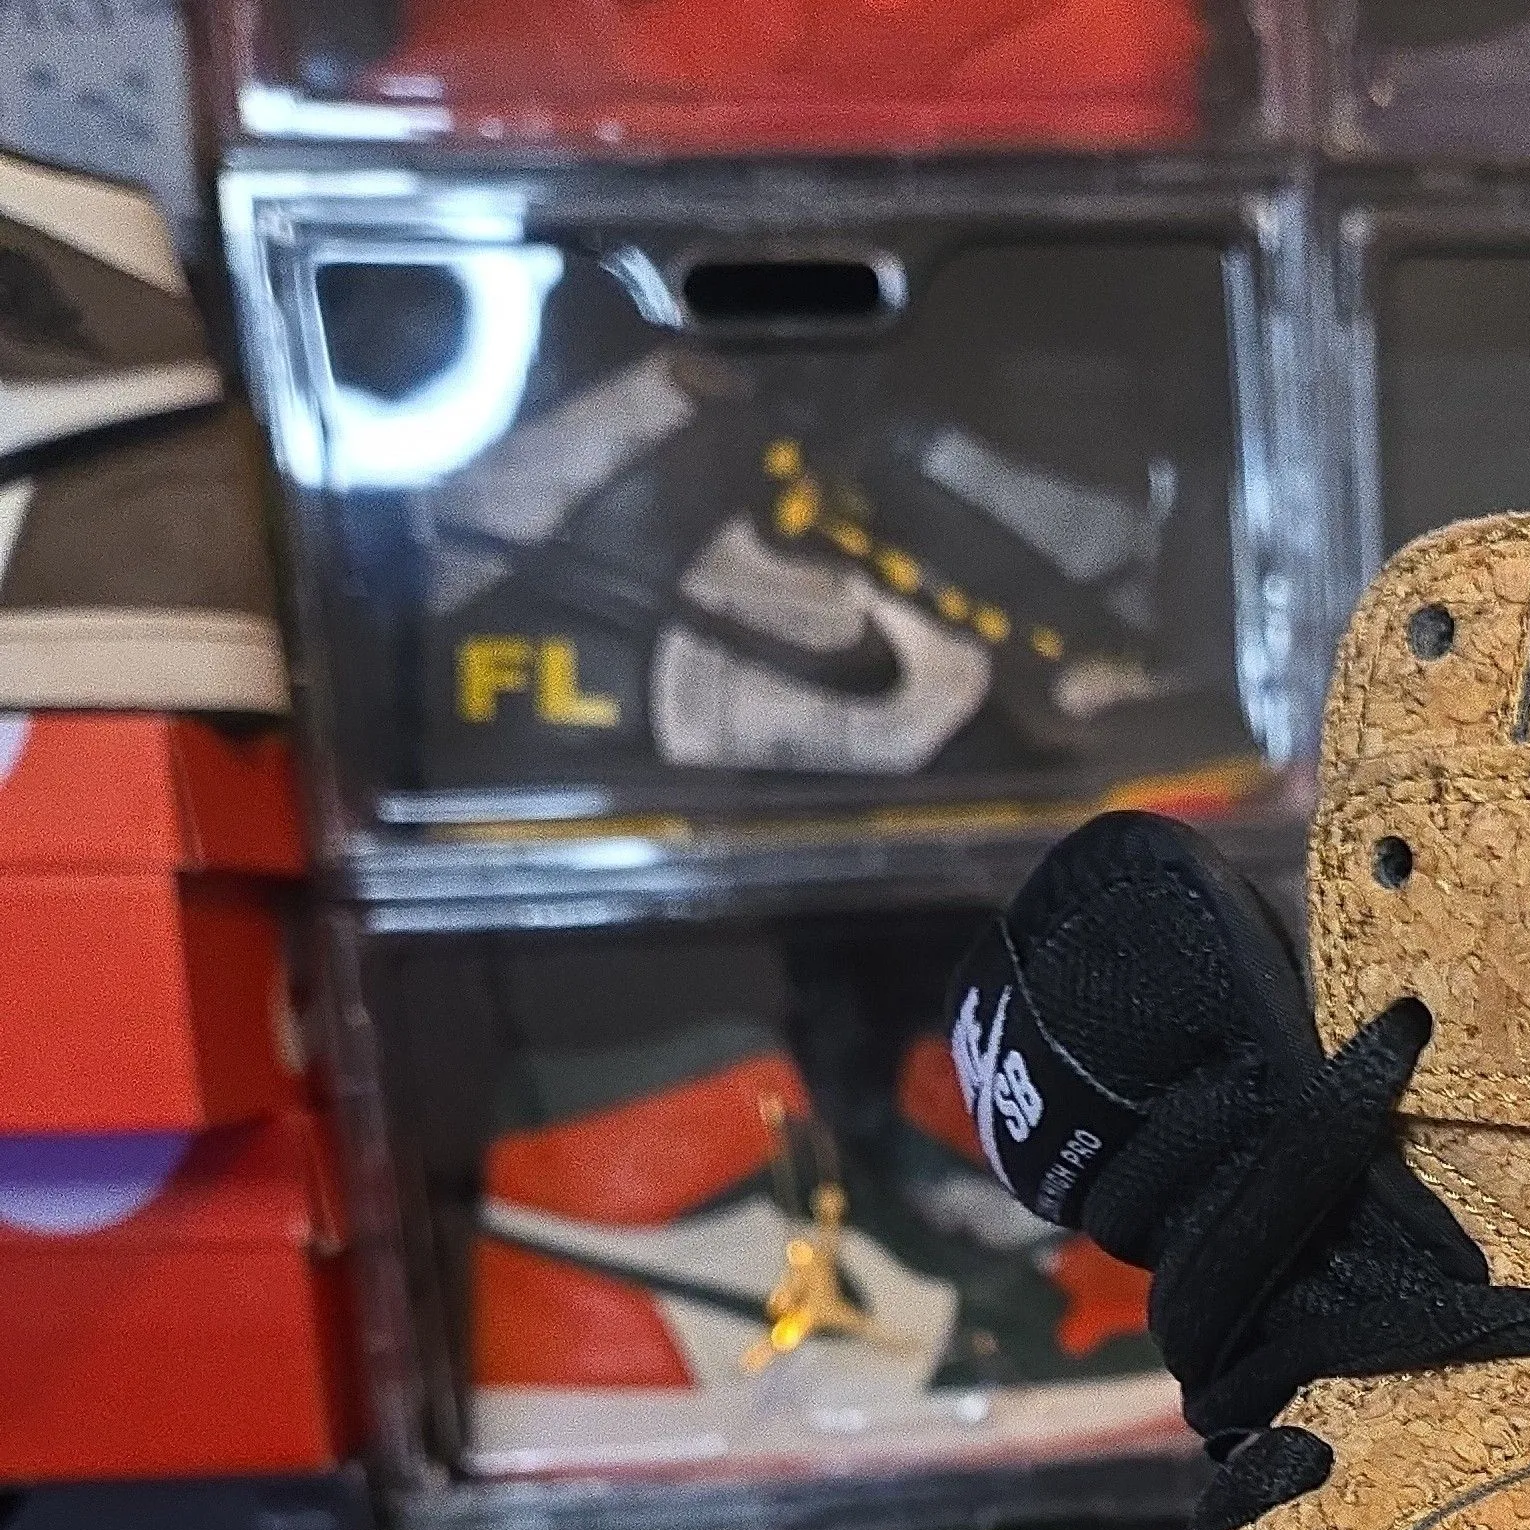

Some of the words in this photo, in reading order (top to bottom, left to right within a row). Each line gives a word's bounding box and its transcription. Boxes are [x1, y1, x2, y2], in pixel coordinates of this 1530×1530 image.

[456, 634, 620, 728] FL
[992, 1050, 1045, 1143] SB
[1060, 1129, 1103, 1170] PRO
